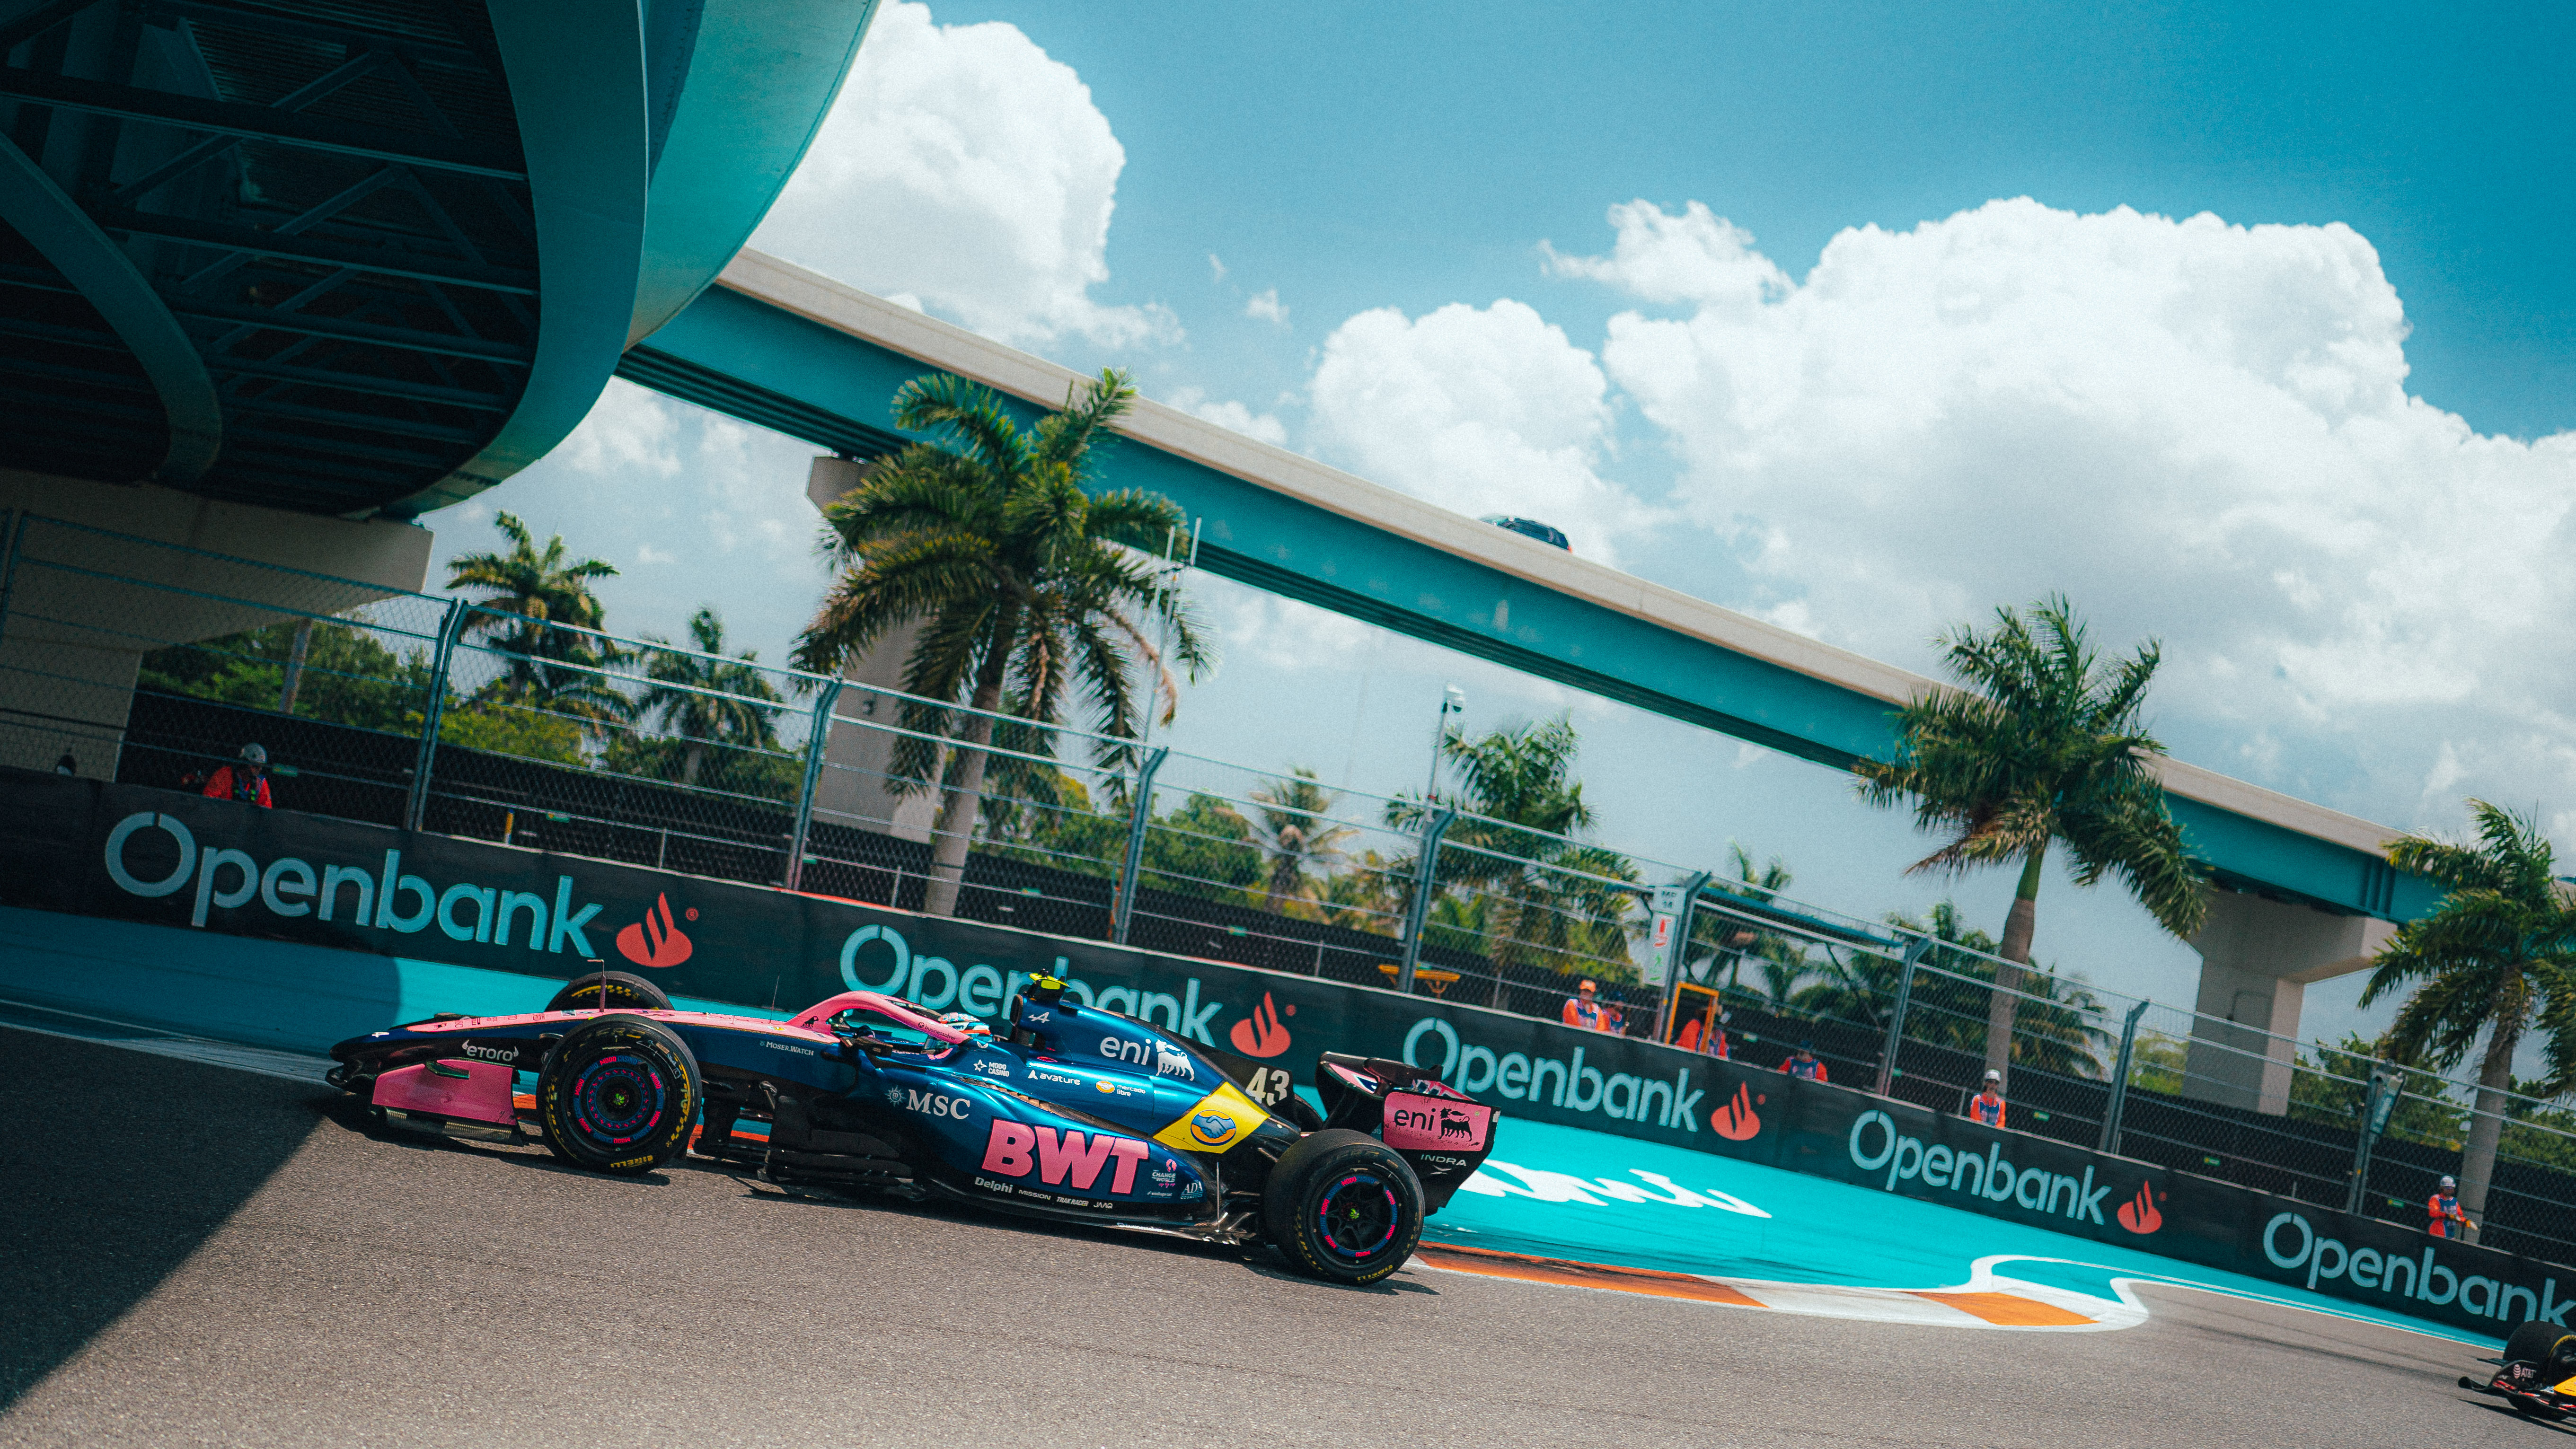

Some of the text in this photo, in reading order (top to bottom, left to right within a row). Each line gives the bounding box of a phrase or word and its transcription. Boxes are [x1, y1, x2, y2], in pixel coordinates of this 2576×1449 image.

[105, 810, 603, 957] Openbank
[1100, 1037, 1151, 1065] eni
[988, 1062, 1006, 1070] MODO
[988, 1068, 1010, 1077] CASINO
[1403, 1017, 1705, 1132] Openbank
[1040, 1073, 1080, 1085] avature
[1245, 1067, 1289, 1106] 43
[1117, 1085, 1146, 1094] mercado
[906, 1089, 970, 1119] MSC
[1394, 1108, 1437, 1131] eni
[981, 1119, 1149, 1194] BWT
[1420, 1154, 1466, 1167] INDRA
[1849, 1109, 2112, 1225] Openbank
[974, 1177, 1013, 1193] Delphi
[1019, 1189, 1051, 1200] MISSION
[1182, 1181, 1202, 1194] ADA
[1056, 1196, 1089, 1207] TRAK RACER
[2263, 1212, 2576, 1327] Openbank
